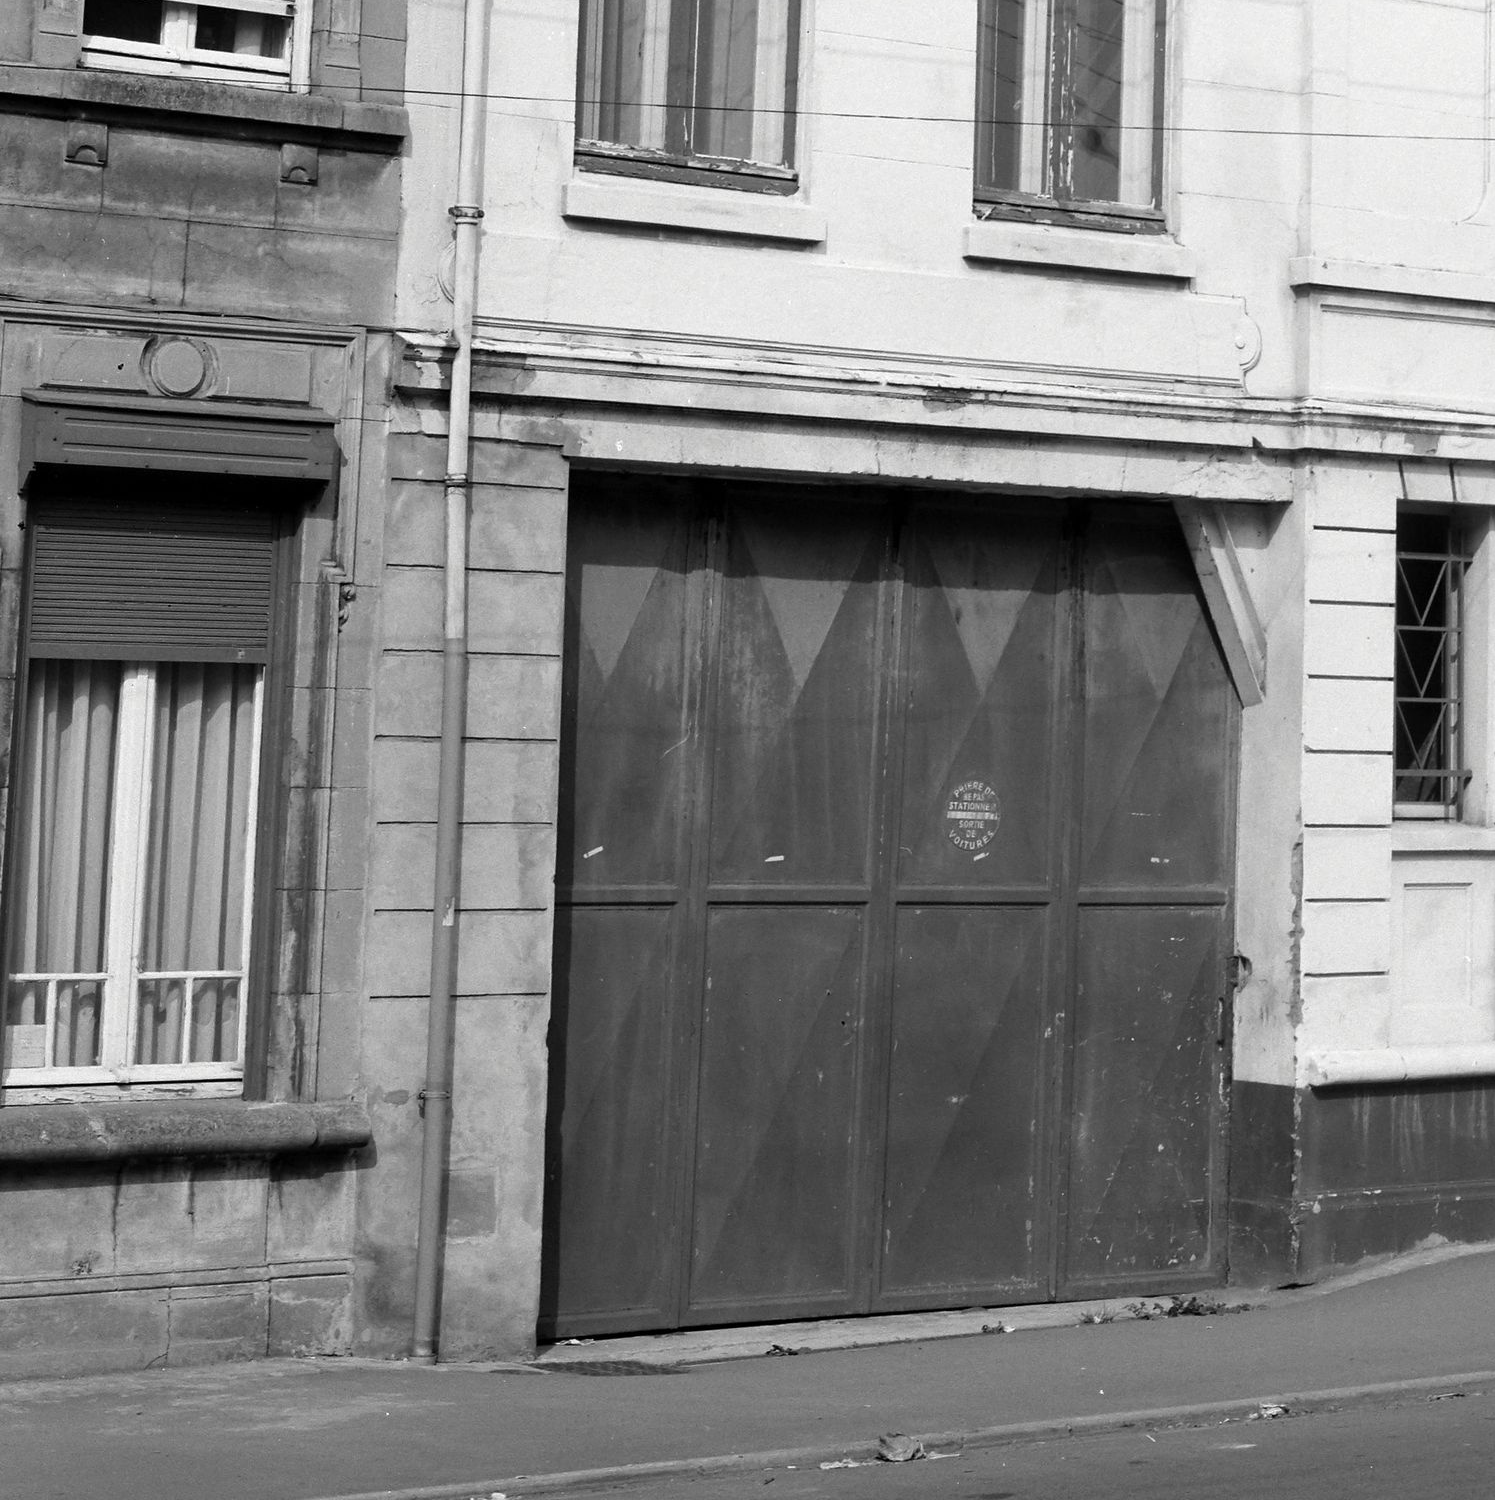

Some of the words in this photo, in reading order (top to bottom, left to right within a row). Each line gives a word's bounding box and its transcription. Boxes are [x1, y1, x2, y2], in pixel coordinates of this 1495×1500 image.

[958, 820, 985, 829] SORTIE
[966, 829, 977, 838] DE
[948, 829, 995, 850] VOITURES
